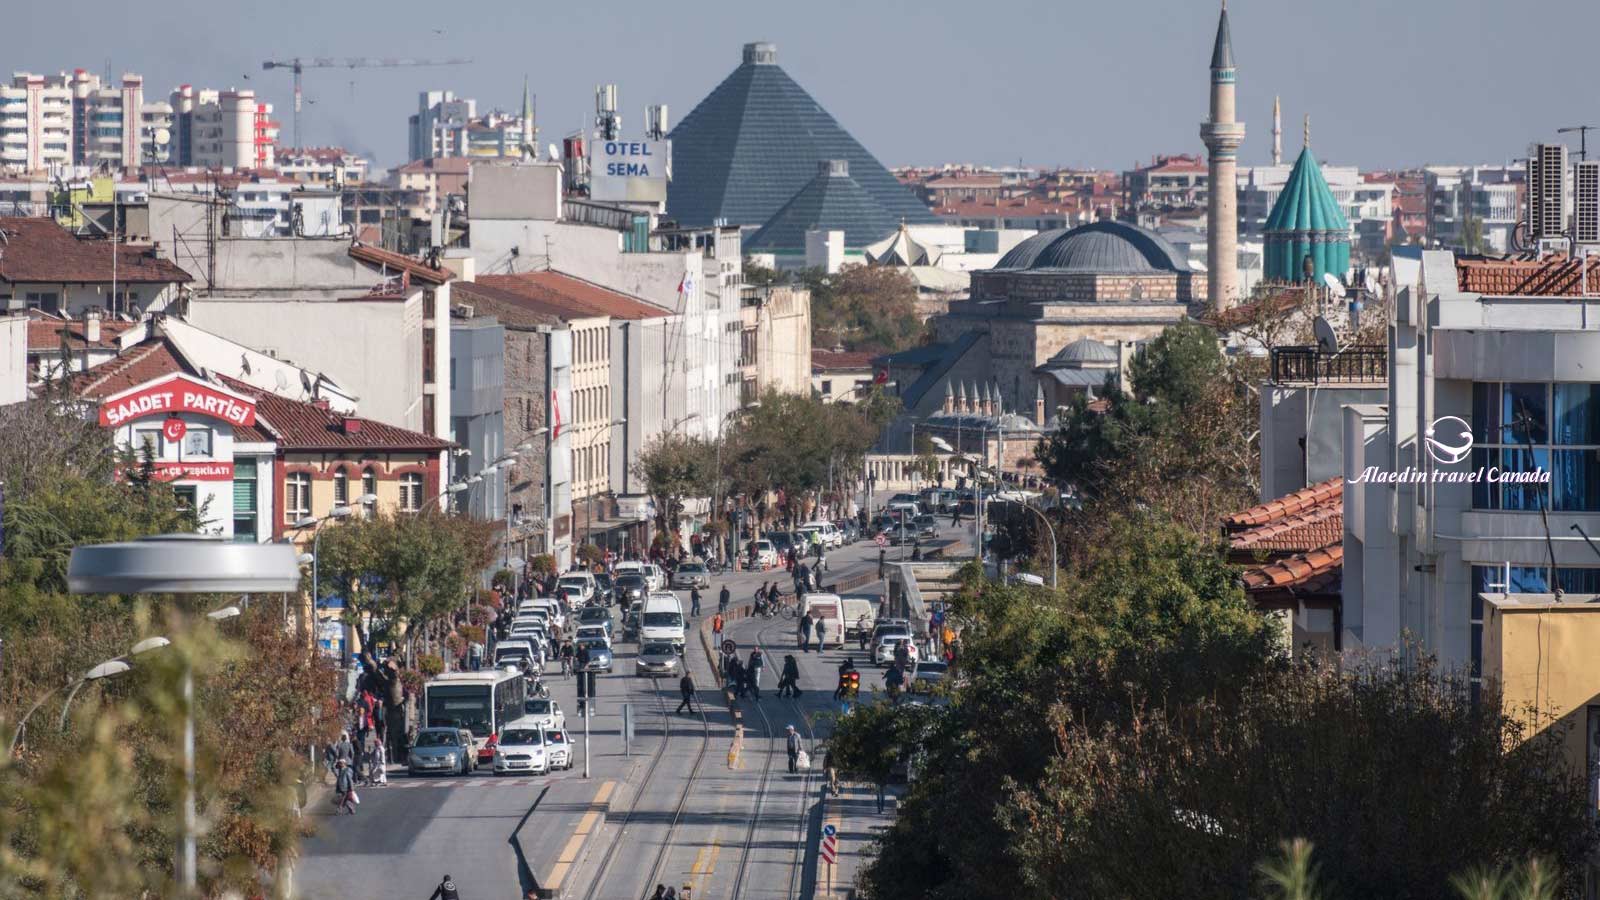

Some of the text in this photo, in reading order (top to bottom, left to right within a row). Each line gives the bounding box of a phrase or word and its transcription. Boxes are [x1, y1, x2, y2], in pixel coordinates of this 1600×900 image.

[605, 143, 652, 156] OTEL
[607, 163, 649, 176] SEMA
[106, 392, 250, 425] SAADET PARTİSİ
